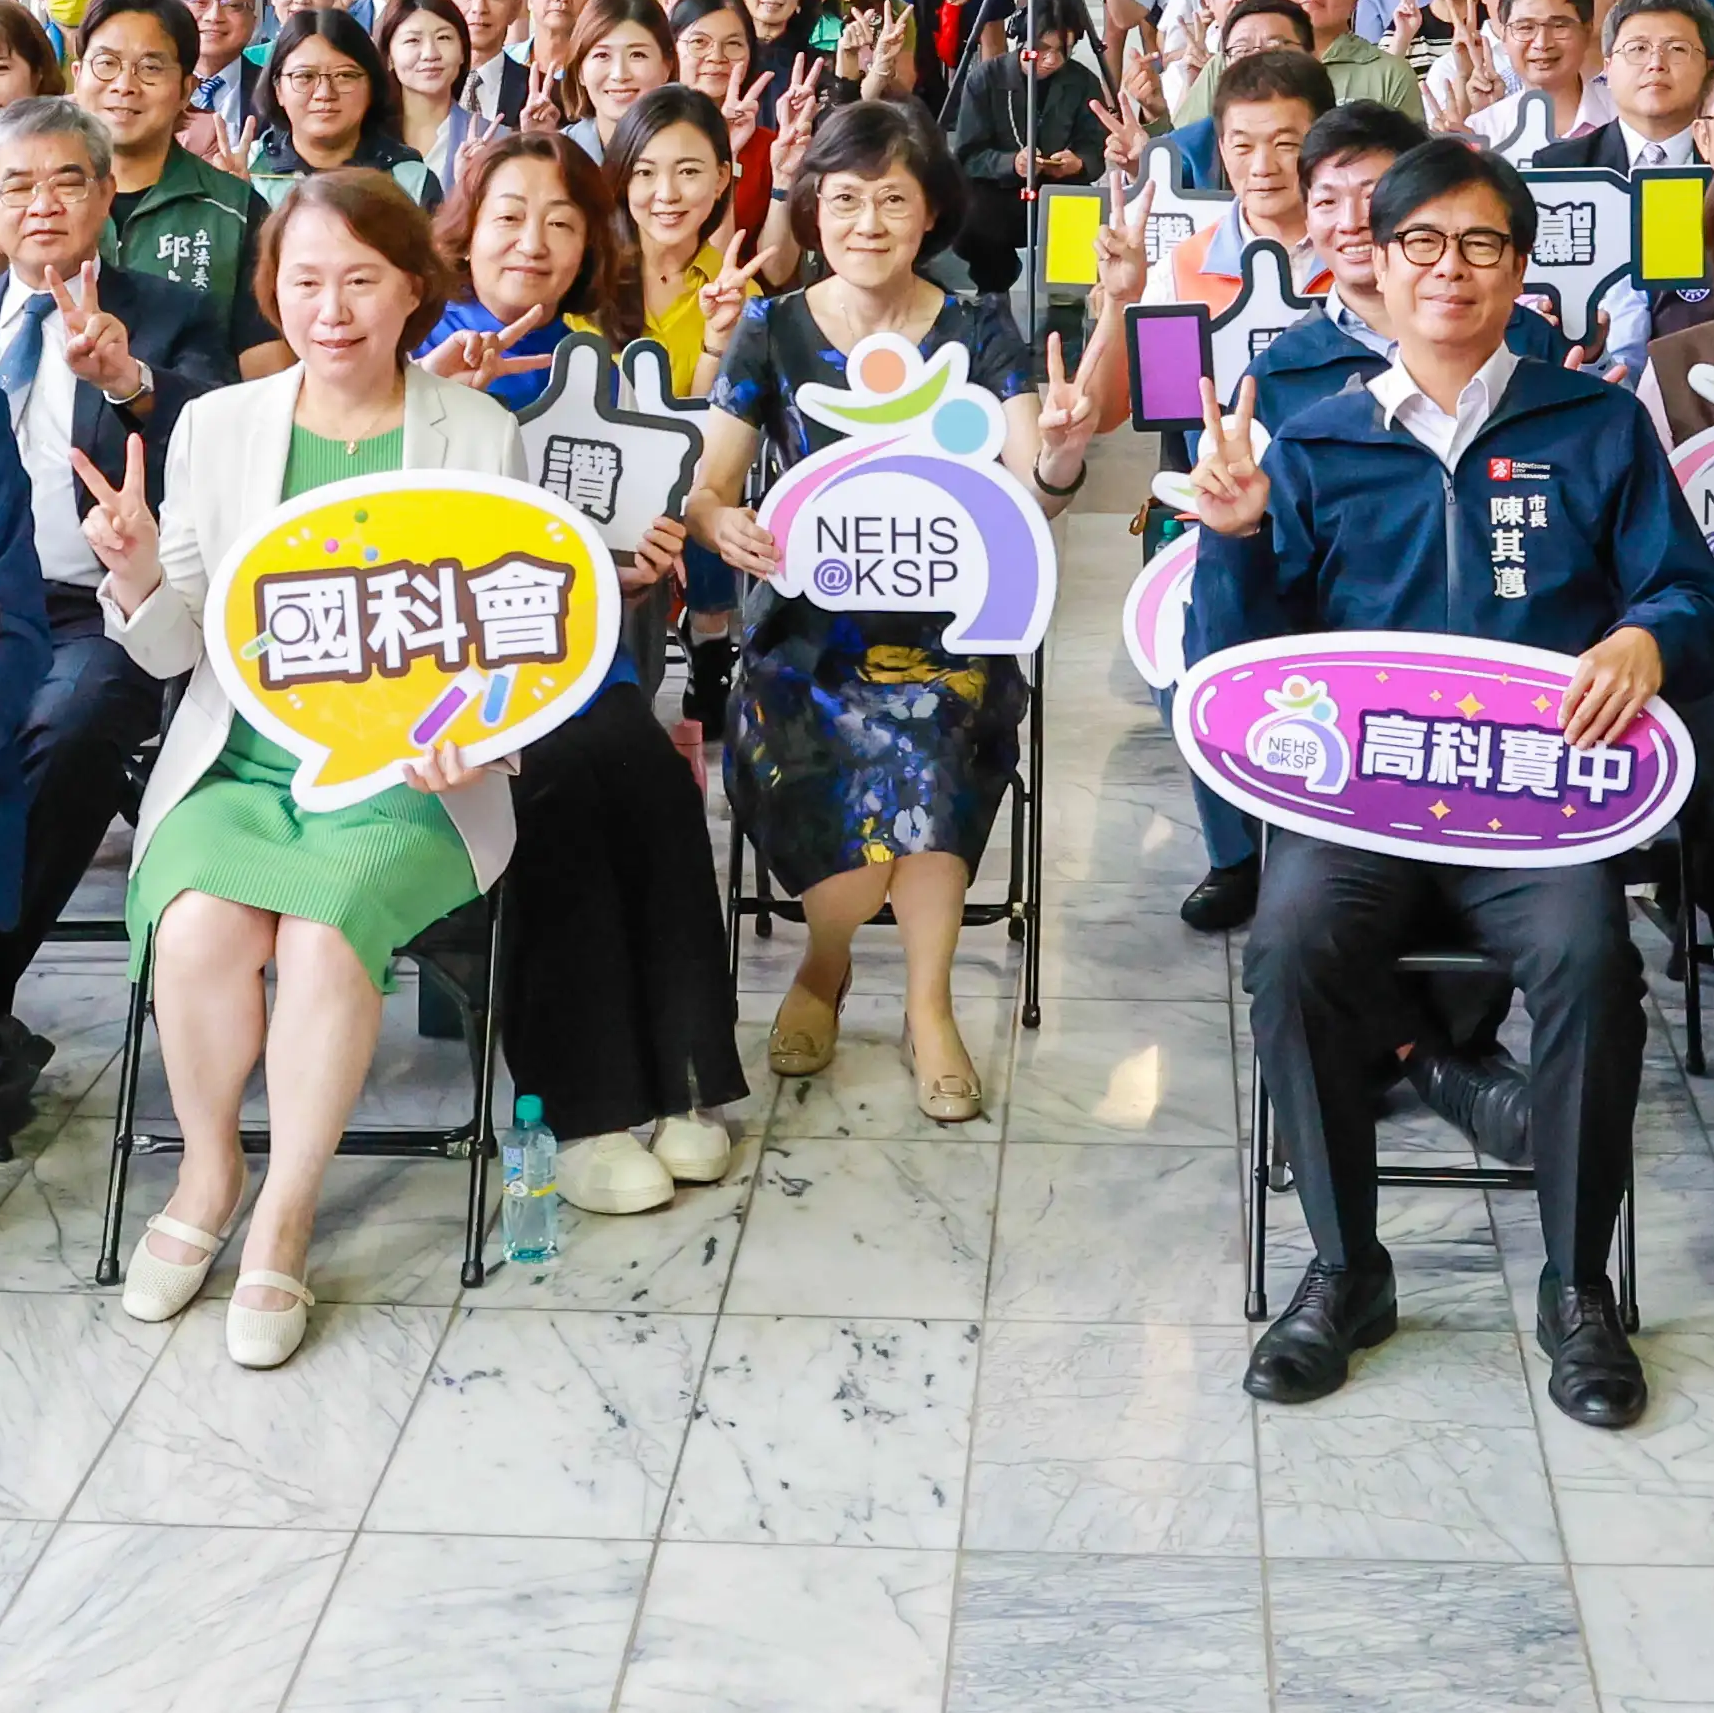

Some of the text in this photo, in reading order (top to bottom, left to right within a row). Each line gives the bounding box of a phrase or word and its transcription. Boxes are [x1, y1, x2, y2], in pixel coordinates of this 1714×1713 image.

[156, 233, 191, 282] 邱
[191, 229, 210, 292] 立法委
[543, 441, 618, 518] 讚
[816, 516, 960, 555] NEHS
[1527, 495, 1547, 528] 市長
[1490, 496, 1527, 599] 陳其邁
[813, 558, 960, 597] @KSP
[264, 561, 567, 683] 國科會
[1268, 736, 1318, 757] NEHS
[1361, 714, 1631, 803] 高科實中
